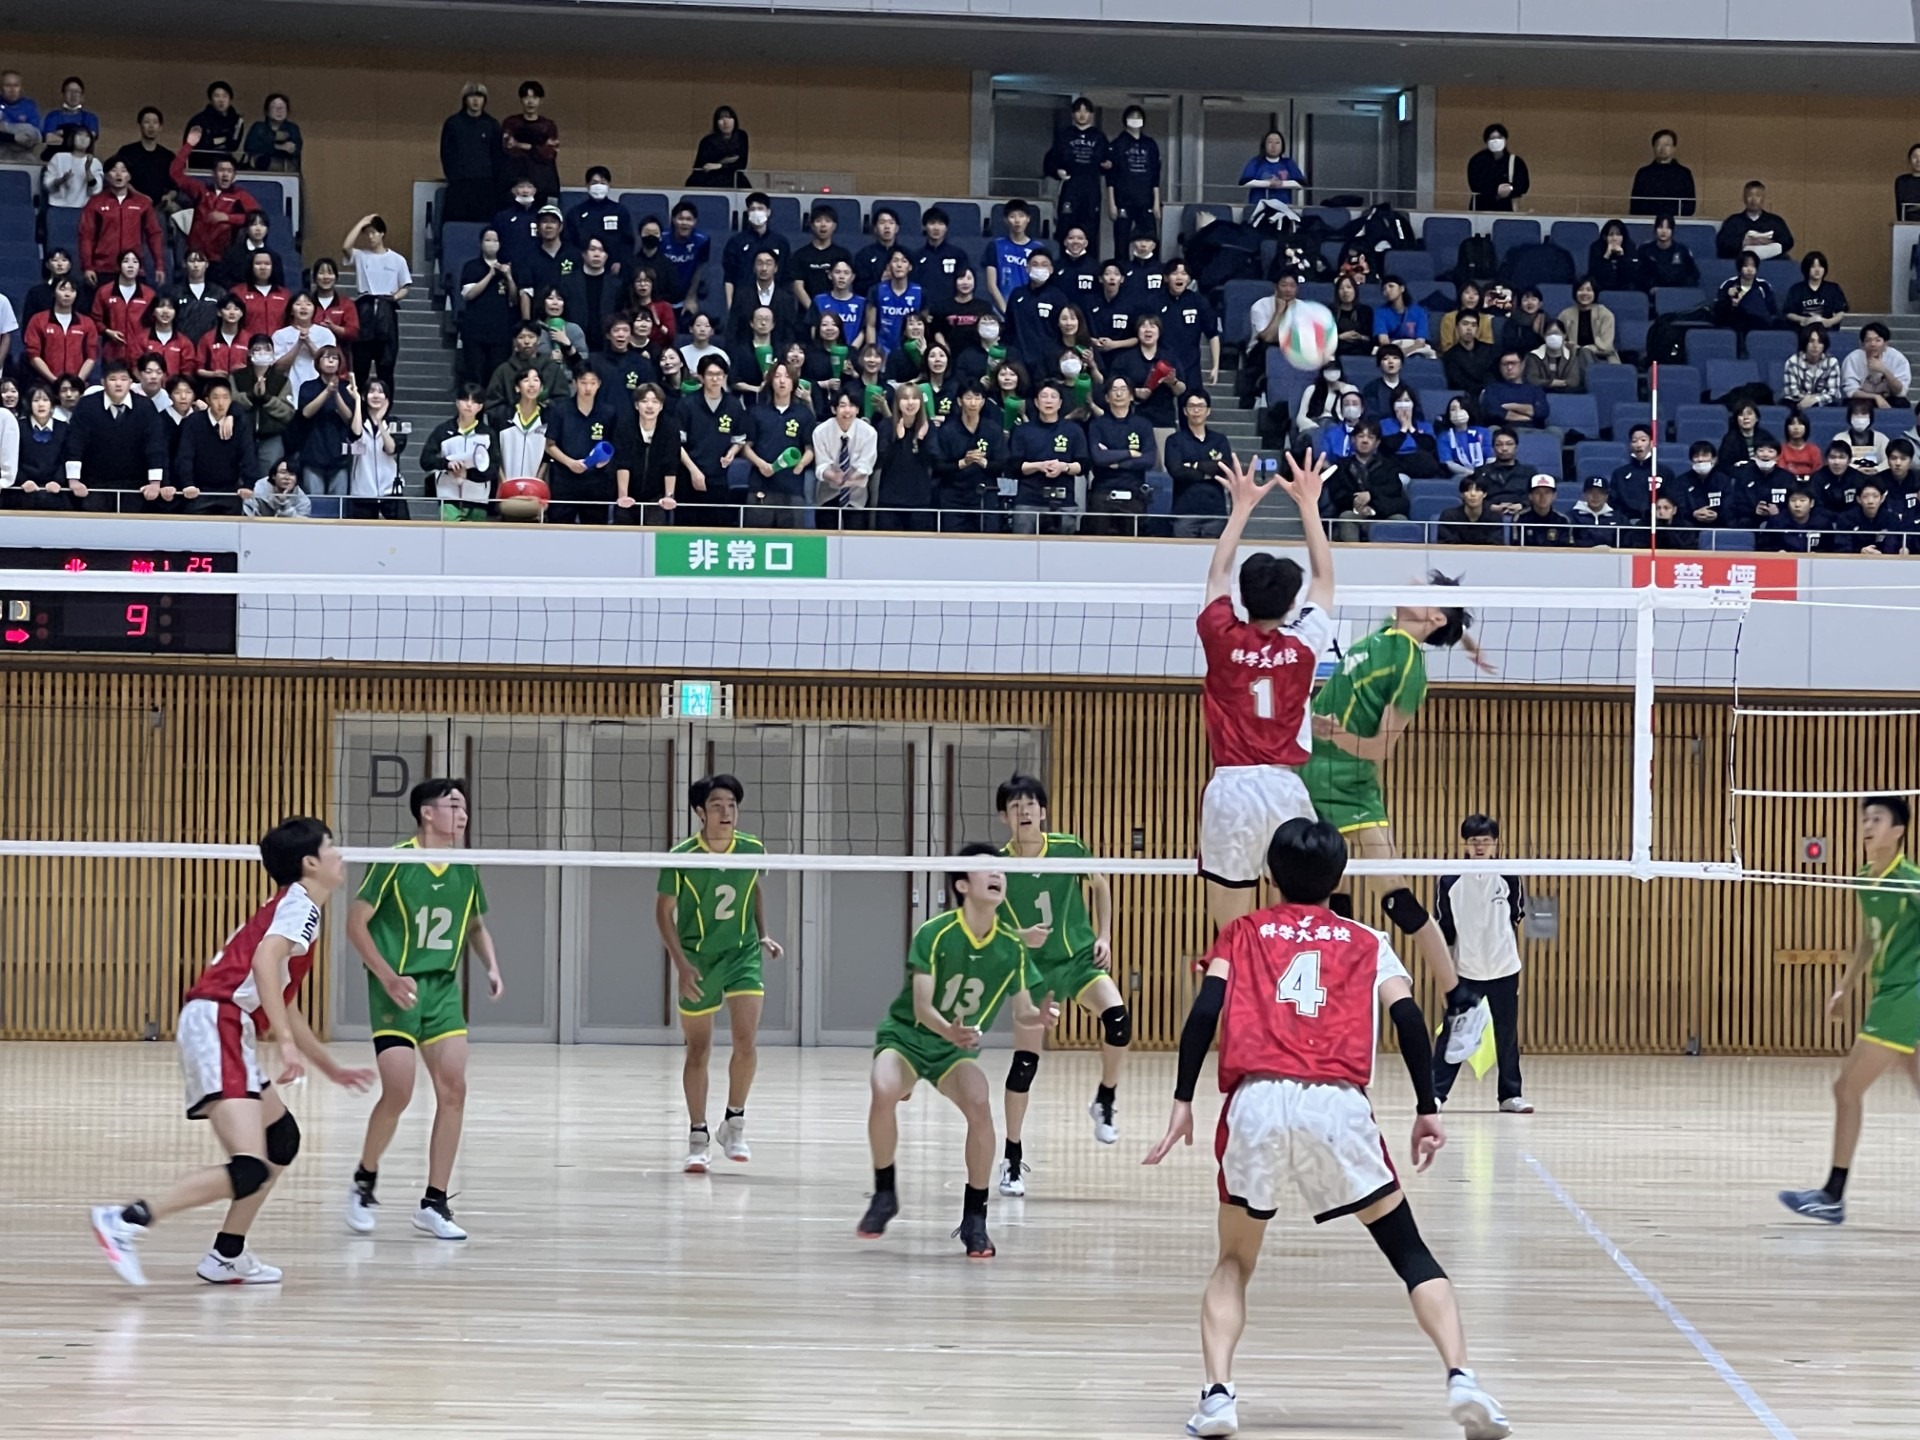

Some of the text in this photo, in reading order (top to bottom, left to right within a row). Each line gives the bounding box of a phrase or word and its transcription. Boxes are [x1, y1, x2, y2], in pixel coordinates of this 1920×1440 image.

[1004, 254, 1028, 267] OKA
[688, 539, 793, 571] 非常口
[1673, 563, 1757, 588] 禁煙
[126, 604, 148, 636] 9
[1249, 676, 1274, 719] 1
[371, 755, 409, 797] D
[714, 884, 736, 920] 2
[1034, 890, 1053, 927] 1
[415, 905, 453, 950] 12
[1259, 922, 1351, 943] 科学大高校
[940, 973, 985, 1017] 13
[1275, 950, 1328, 1017] 4
